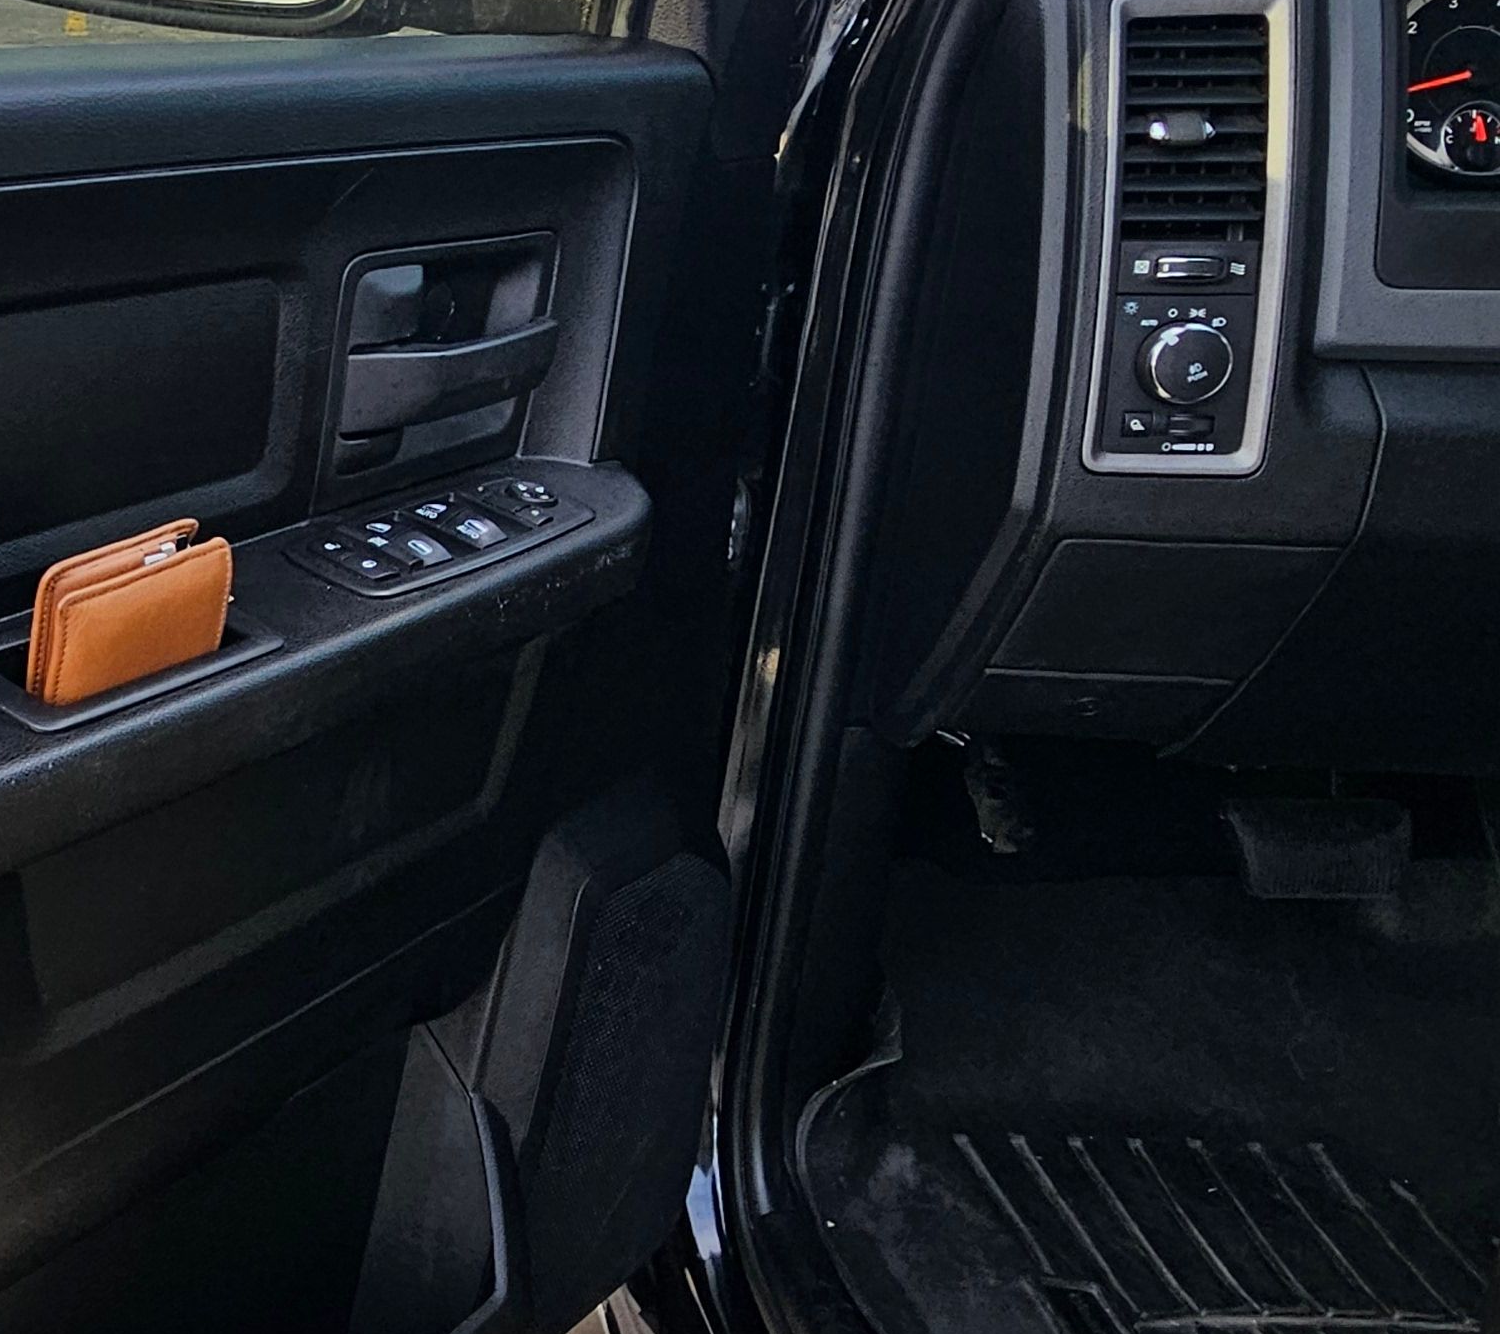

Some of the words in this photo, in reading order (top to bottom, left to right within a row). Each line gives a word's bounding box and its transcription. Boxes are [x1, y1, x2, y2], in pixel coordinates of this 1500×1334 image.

[1407, 21, 1418, 34] 2
[1445, 134, 1454, 144] C
[414, 508, 438, 519] AUTO
